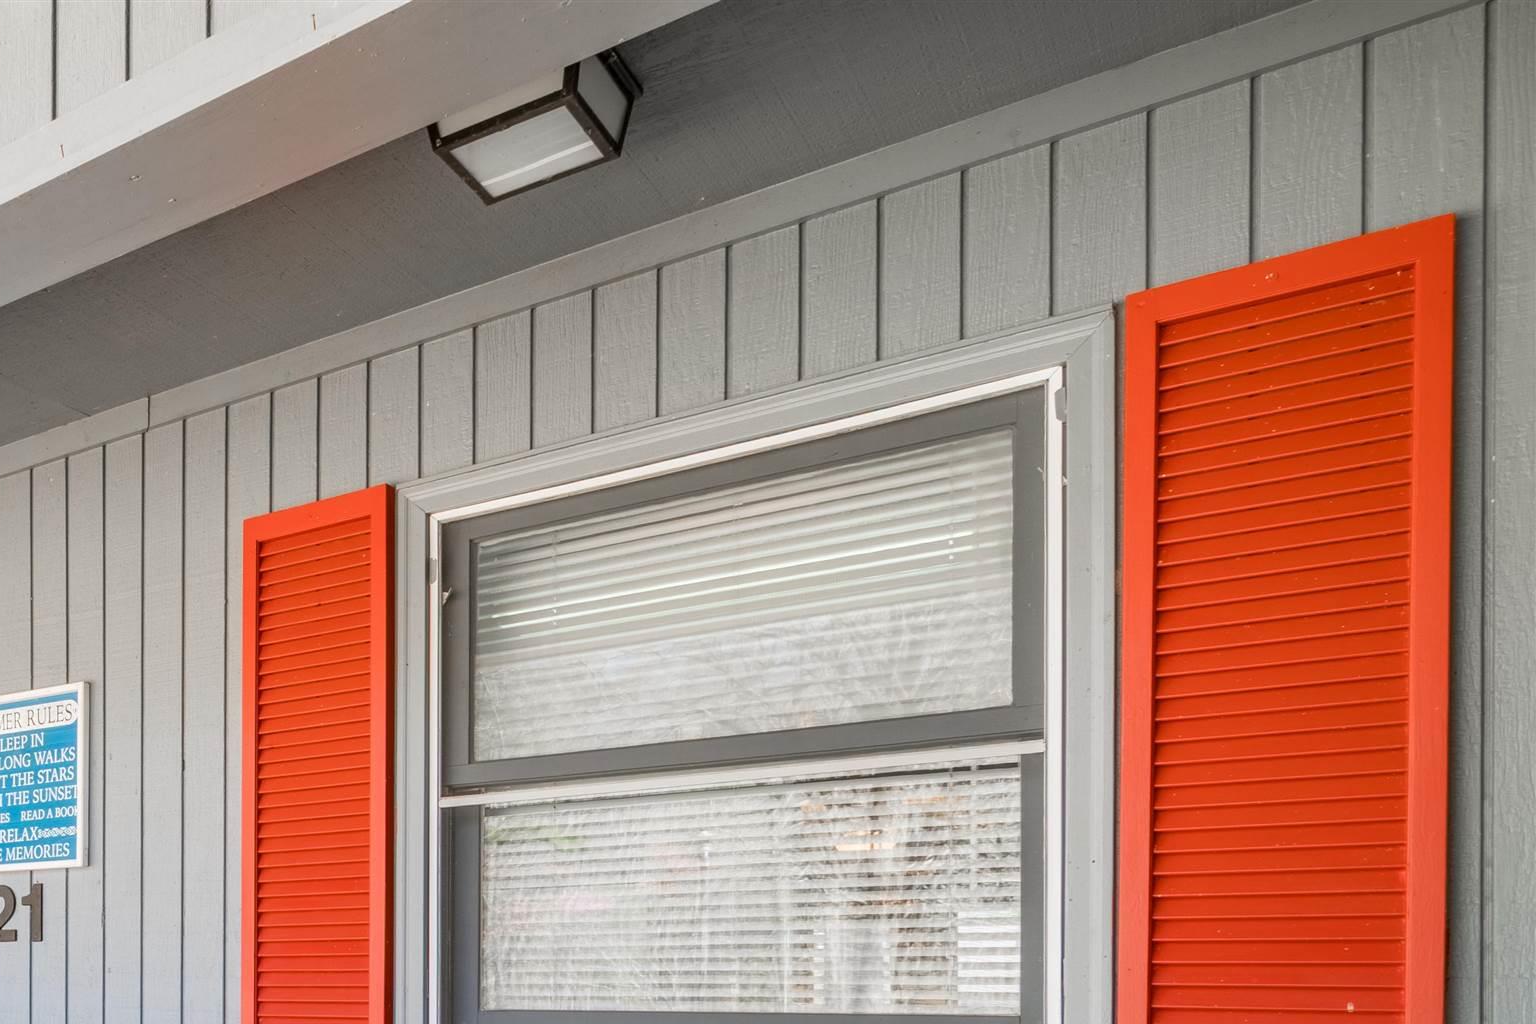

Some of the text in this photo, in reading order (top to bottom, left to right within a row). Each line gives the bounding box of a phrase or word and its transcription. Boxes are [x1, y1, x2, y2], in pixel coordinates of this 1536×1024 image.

[27, 703, 73, 727] RULES
[31, 733, 44, 747] IN
[34, 747, 76, 766] WALKS
[10, 771, 35, 788] THE
[37, 766, 74, 784] STARS
[5, 791, 30, 807] THE
[20, 809, 45, 822] READ
[46, 808, 53, 818] A
[0, 827, 39, 844] RELAX
[5, 842, 71, 861] MEMORIES
